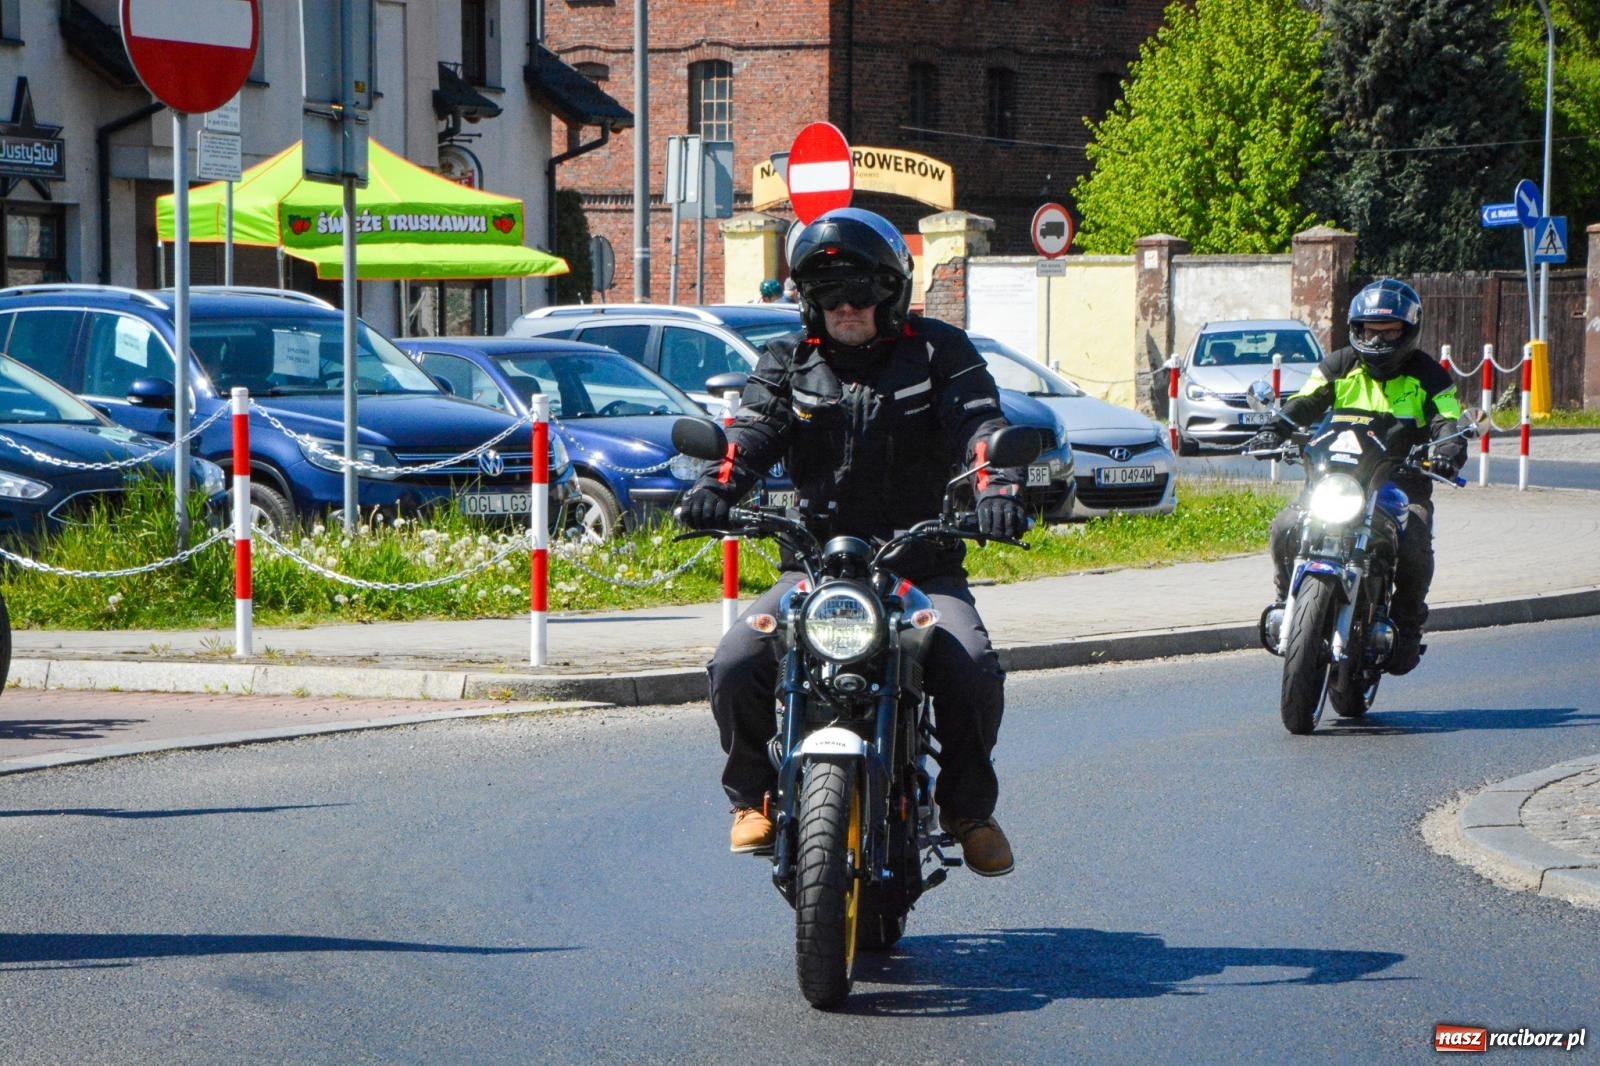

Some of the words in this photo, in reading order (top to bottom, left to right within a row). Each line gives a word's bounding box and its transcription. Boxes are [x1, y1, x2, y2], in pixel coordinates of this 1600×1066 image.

[0, 140, 58, 166] JustyStyl
[852, 150, 945, 181] ROWERÓW
[317, 210, 382, 234] ŚWEŻE
[387, 213, 487, 233] TRUSKAWKI
[1103, 468, 1117, 483] WJ
[1121, 468, 1153, 483] 0494M
[468, 496, 496, 512] OGL
